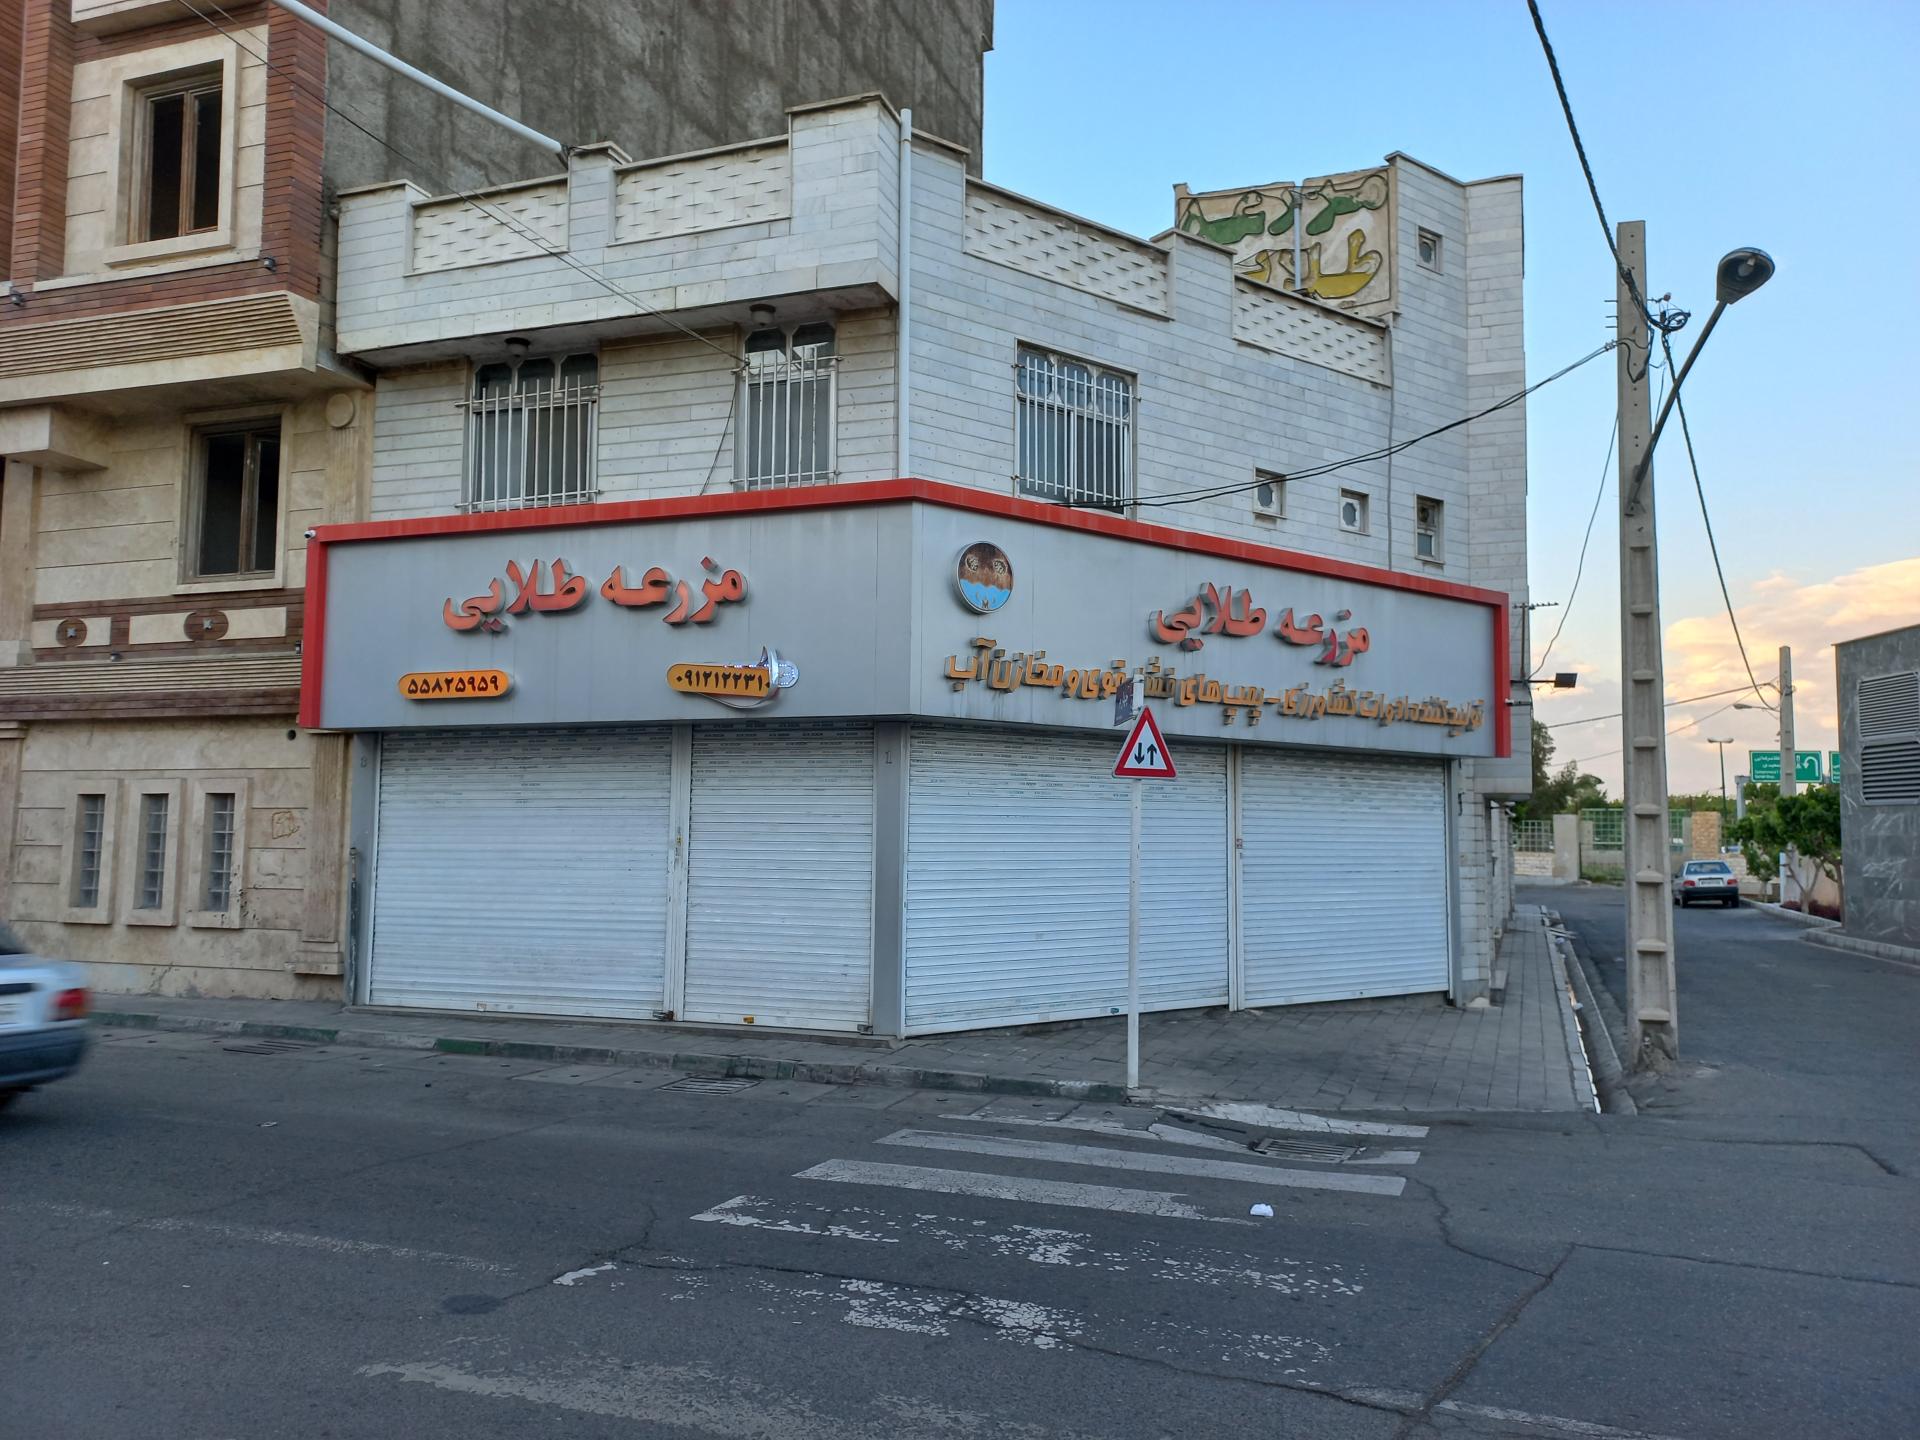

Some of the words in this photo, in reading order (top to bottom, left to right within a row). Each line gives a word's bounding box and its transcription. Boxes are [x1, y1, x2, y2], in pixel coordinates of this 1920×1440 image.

[443, 558, 588, 632] طلایی
[600, 556, 747, 624] مزرعه
[1149, 582, 1266, 650] طلایی
[945, 637, 998, 692] آب
[1274, 607, 1369, 667] مزرعه
[407, 675, 499, 694] ۵۵۸۲۵۹۵۹
[987, 650, 1064, 693] مخازن
[1061, 668, 1080, 699] و
